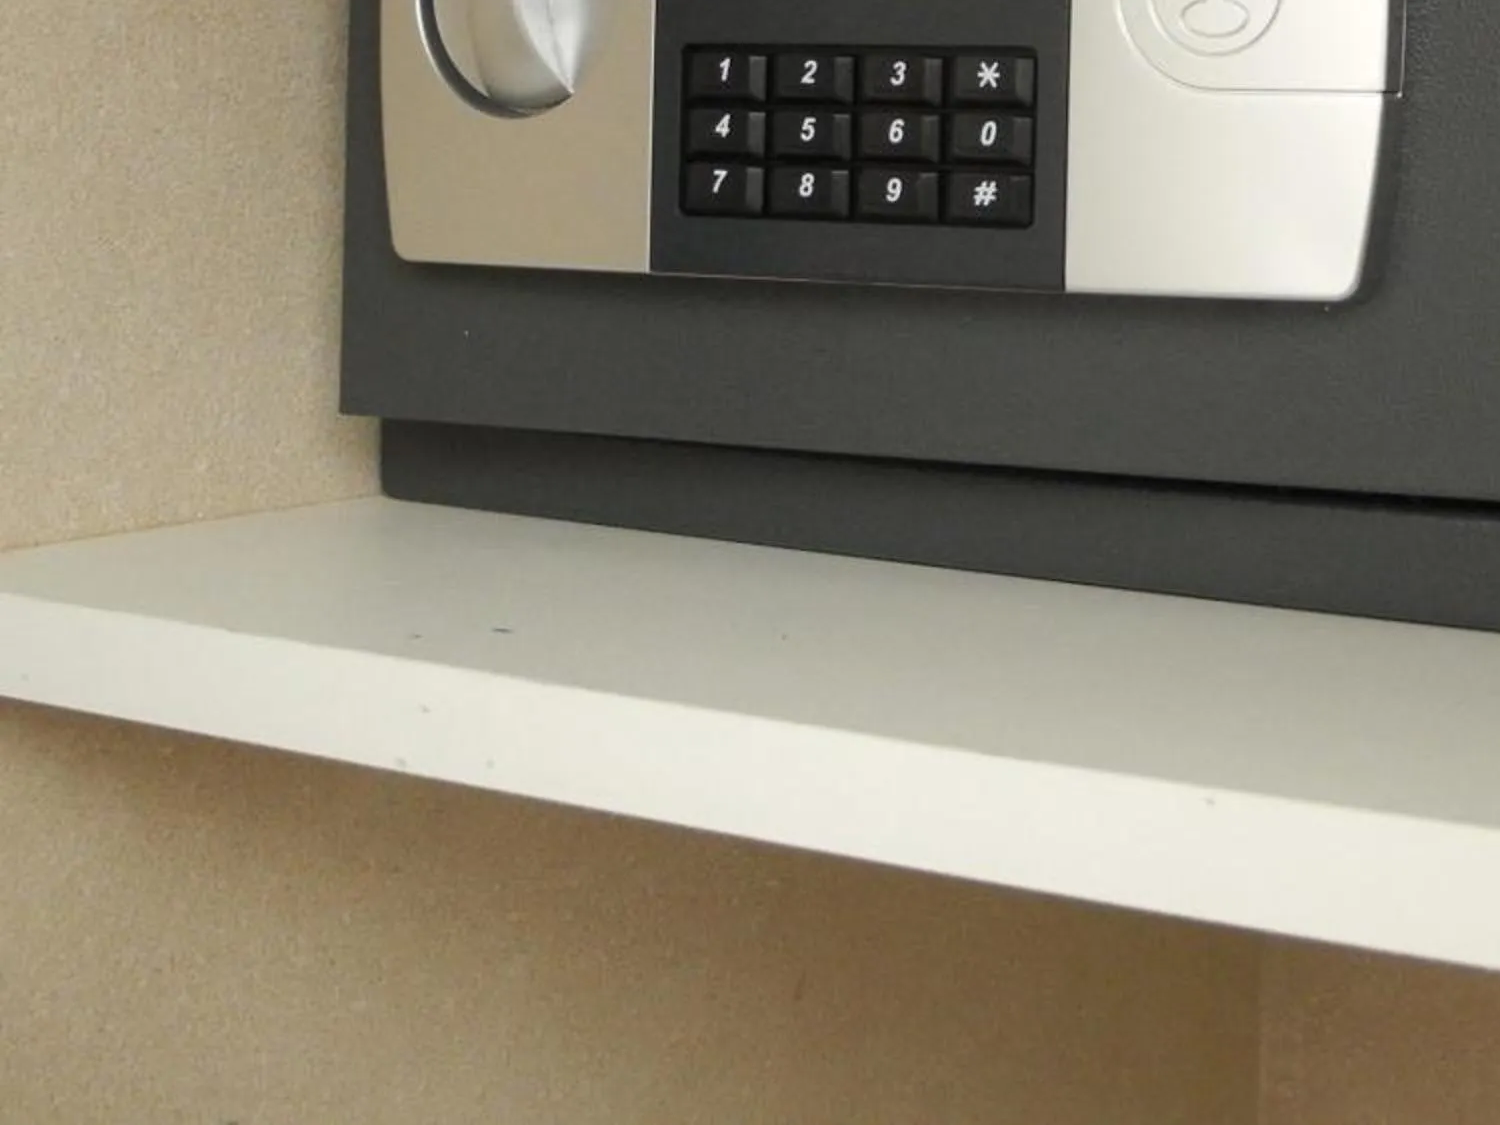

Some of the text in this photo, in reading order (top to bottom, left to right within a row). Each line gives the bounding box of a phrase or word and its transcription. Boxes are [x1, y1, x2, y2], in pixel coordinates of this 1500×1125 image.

[719, 57, 731, 81] 1
[800, 60, 817, 84] 2
[889, 61, 907, 85] 3
[714, 114, 997, 146] 4 5 6 0
[712, 170, 997, 206] 7 8 9 #
